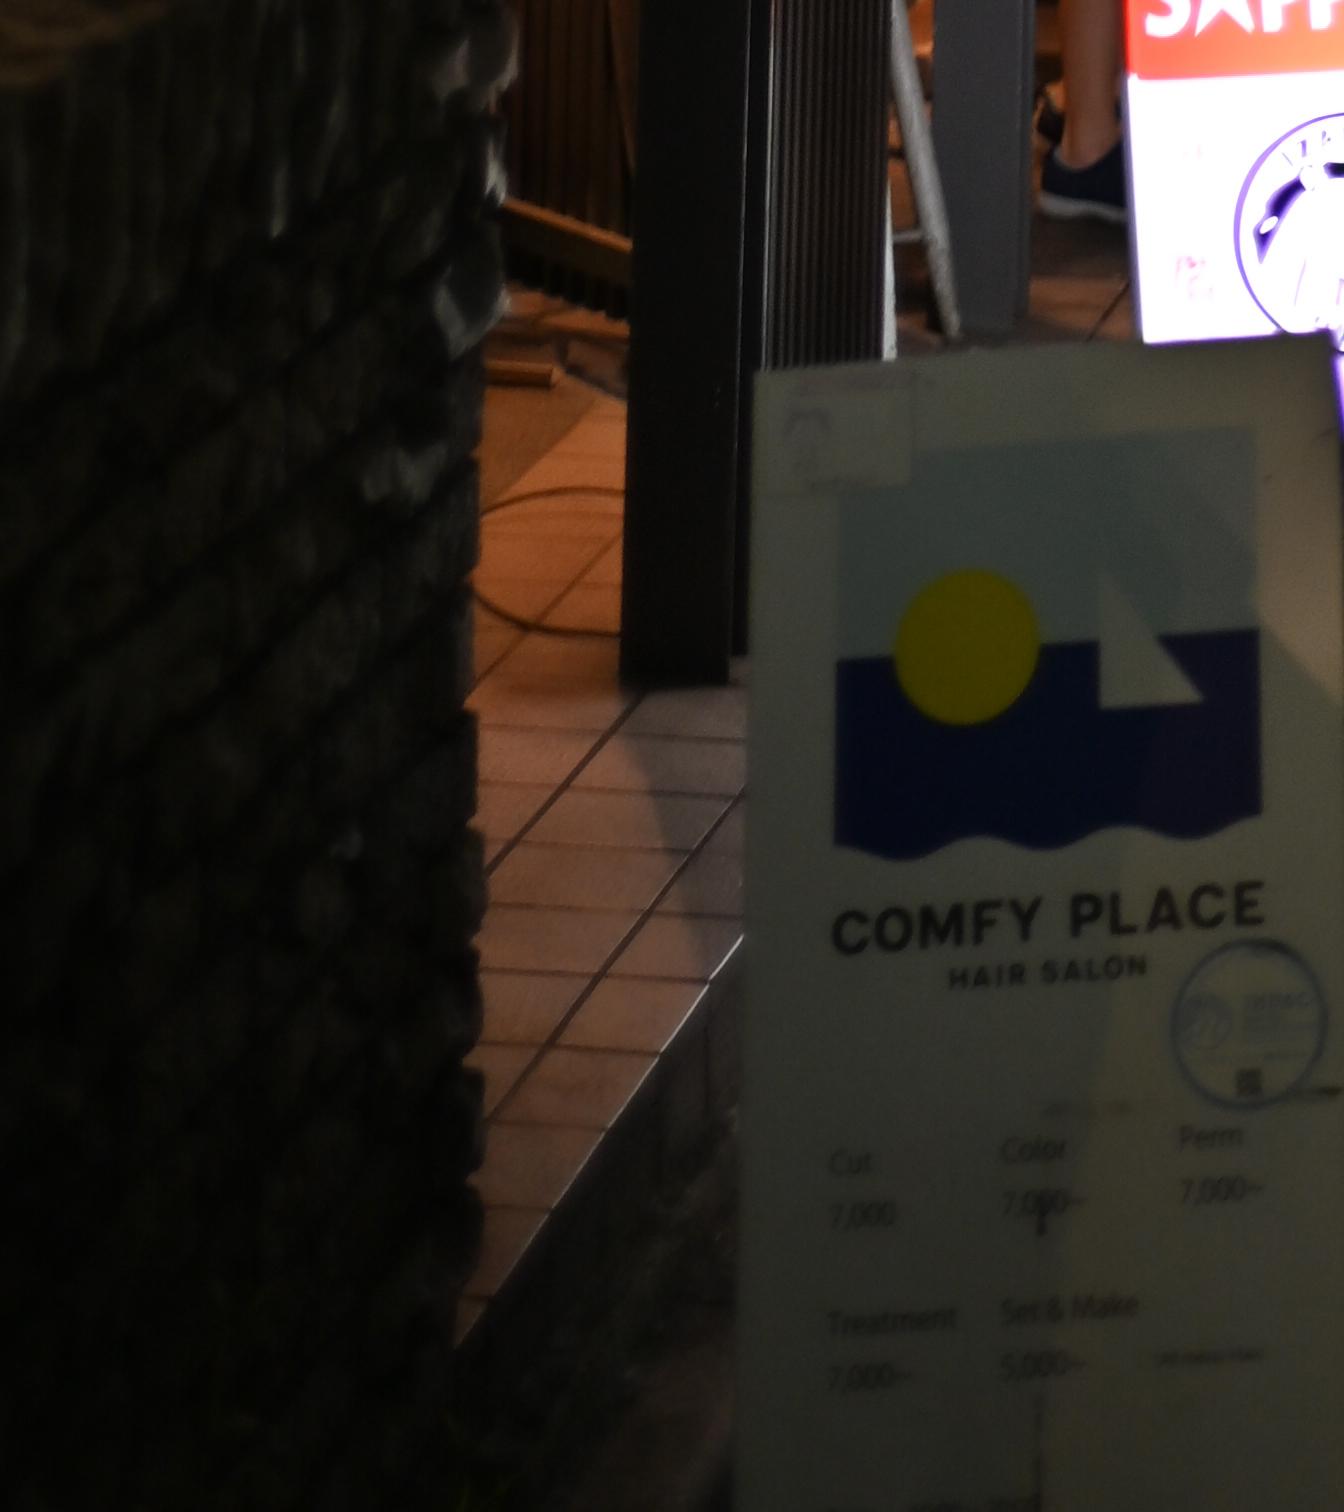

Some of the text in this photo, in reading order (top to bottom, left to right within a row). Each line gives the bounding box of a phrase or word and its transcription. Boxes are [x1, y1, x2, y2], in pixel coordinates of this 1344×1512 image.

[832, 880, 1266, 955] COMFY PLACE
[949, 953, 1148, 990] HAIR SALON
[1000, 1135, 1068, 1164] Color
